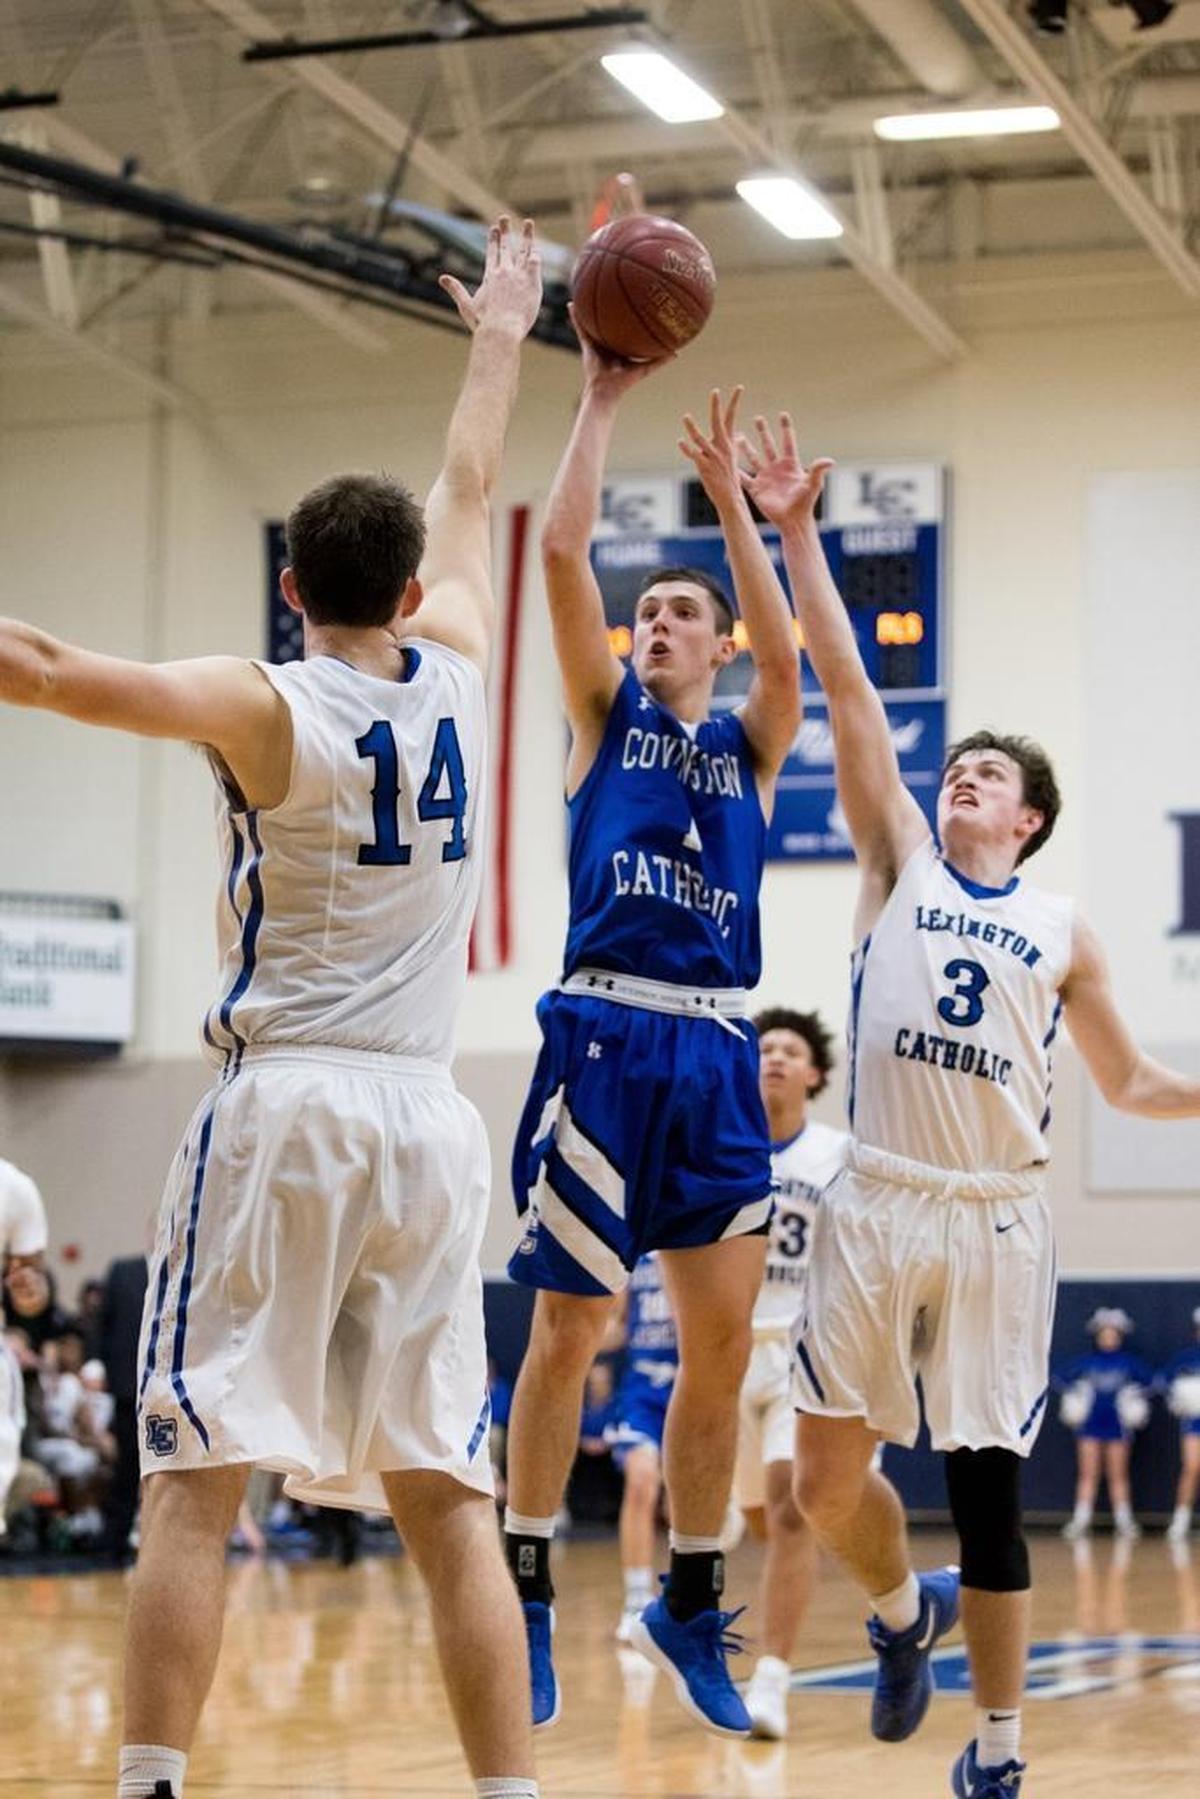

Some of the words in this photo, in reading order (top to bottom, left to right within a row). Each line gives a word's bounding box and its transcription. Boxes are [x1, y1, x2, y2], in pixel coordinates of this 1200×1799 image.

[355, 717, 468, 865] 14
[915, 905, 1043, 970] LEXINGTON
[937, 958, 991, 1027] 3
[894, 1028, 1013, 1086] CATHOLIC
